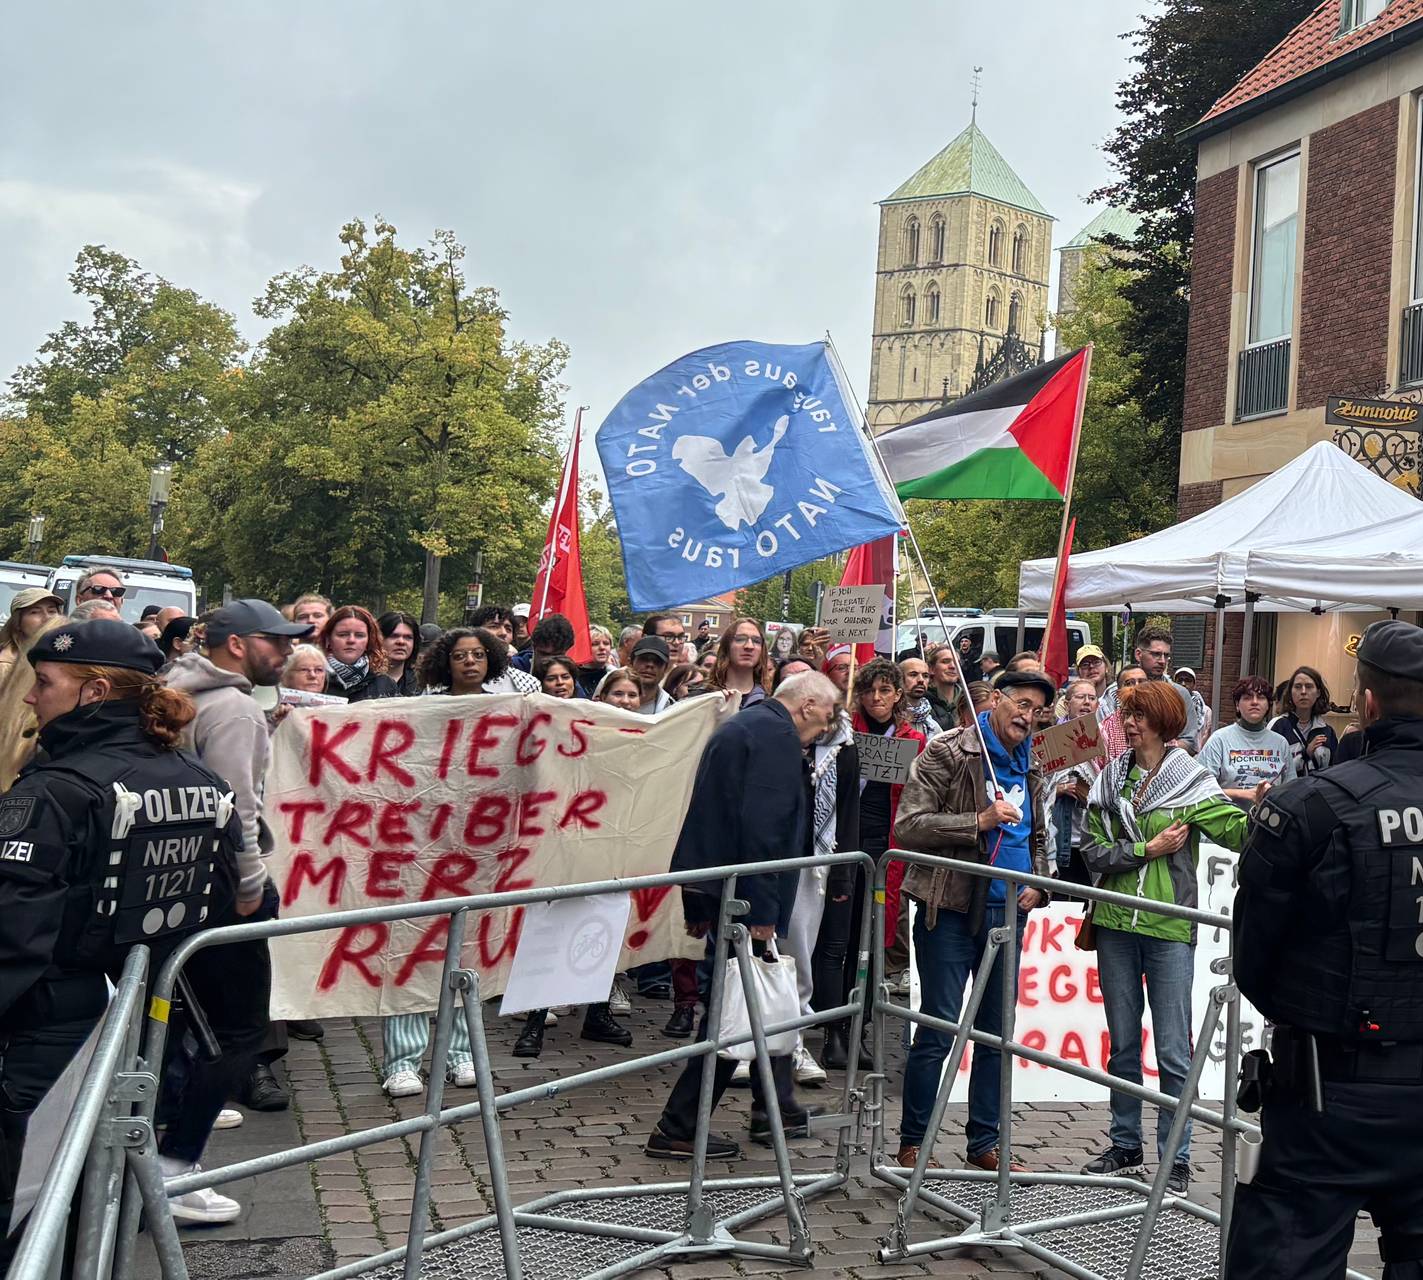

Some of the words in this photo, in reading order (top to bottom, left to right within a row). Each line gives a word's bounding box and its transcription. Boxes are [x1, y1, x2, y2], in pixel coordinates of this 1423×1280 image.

[1335, 400, 1419, 424] Zumnorde
[857, 746, 903, 766] SRAEL
[859, 762, 904, 780] ETZT
[279, 790, 608, 847] TREIBER
[143, 835, 204, 867] NRW
[145, 867, 196, 901] 1121
[282, 848, 536, 908] MERZ
